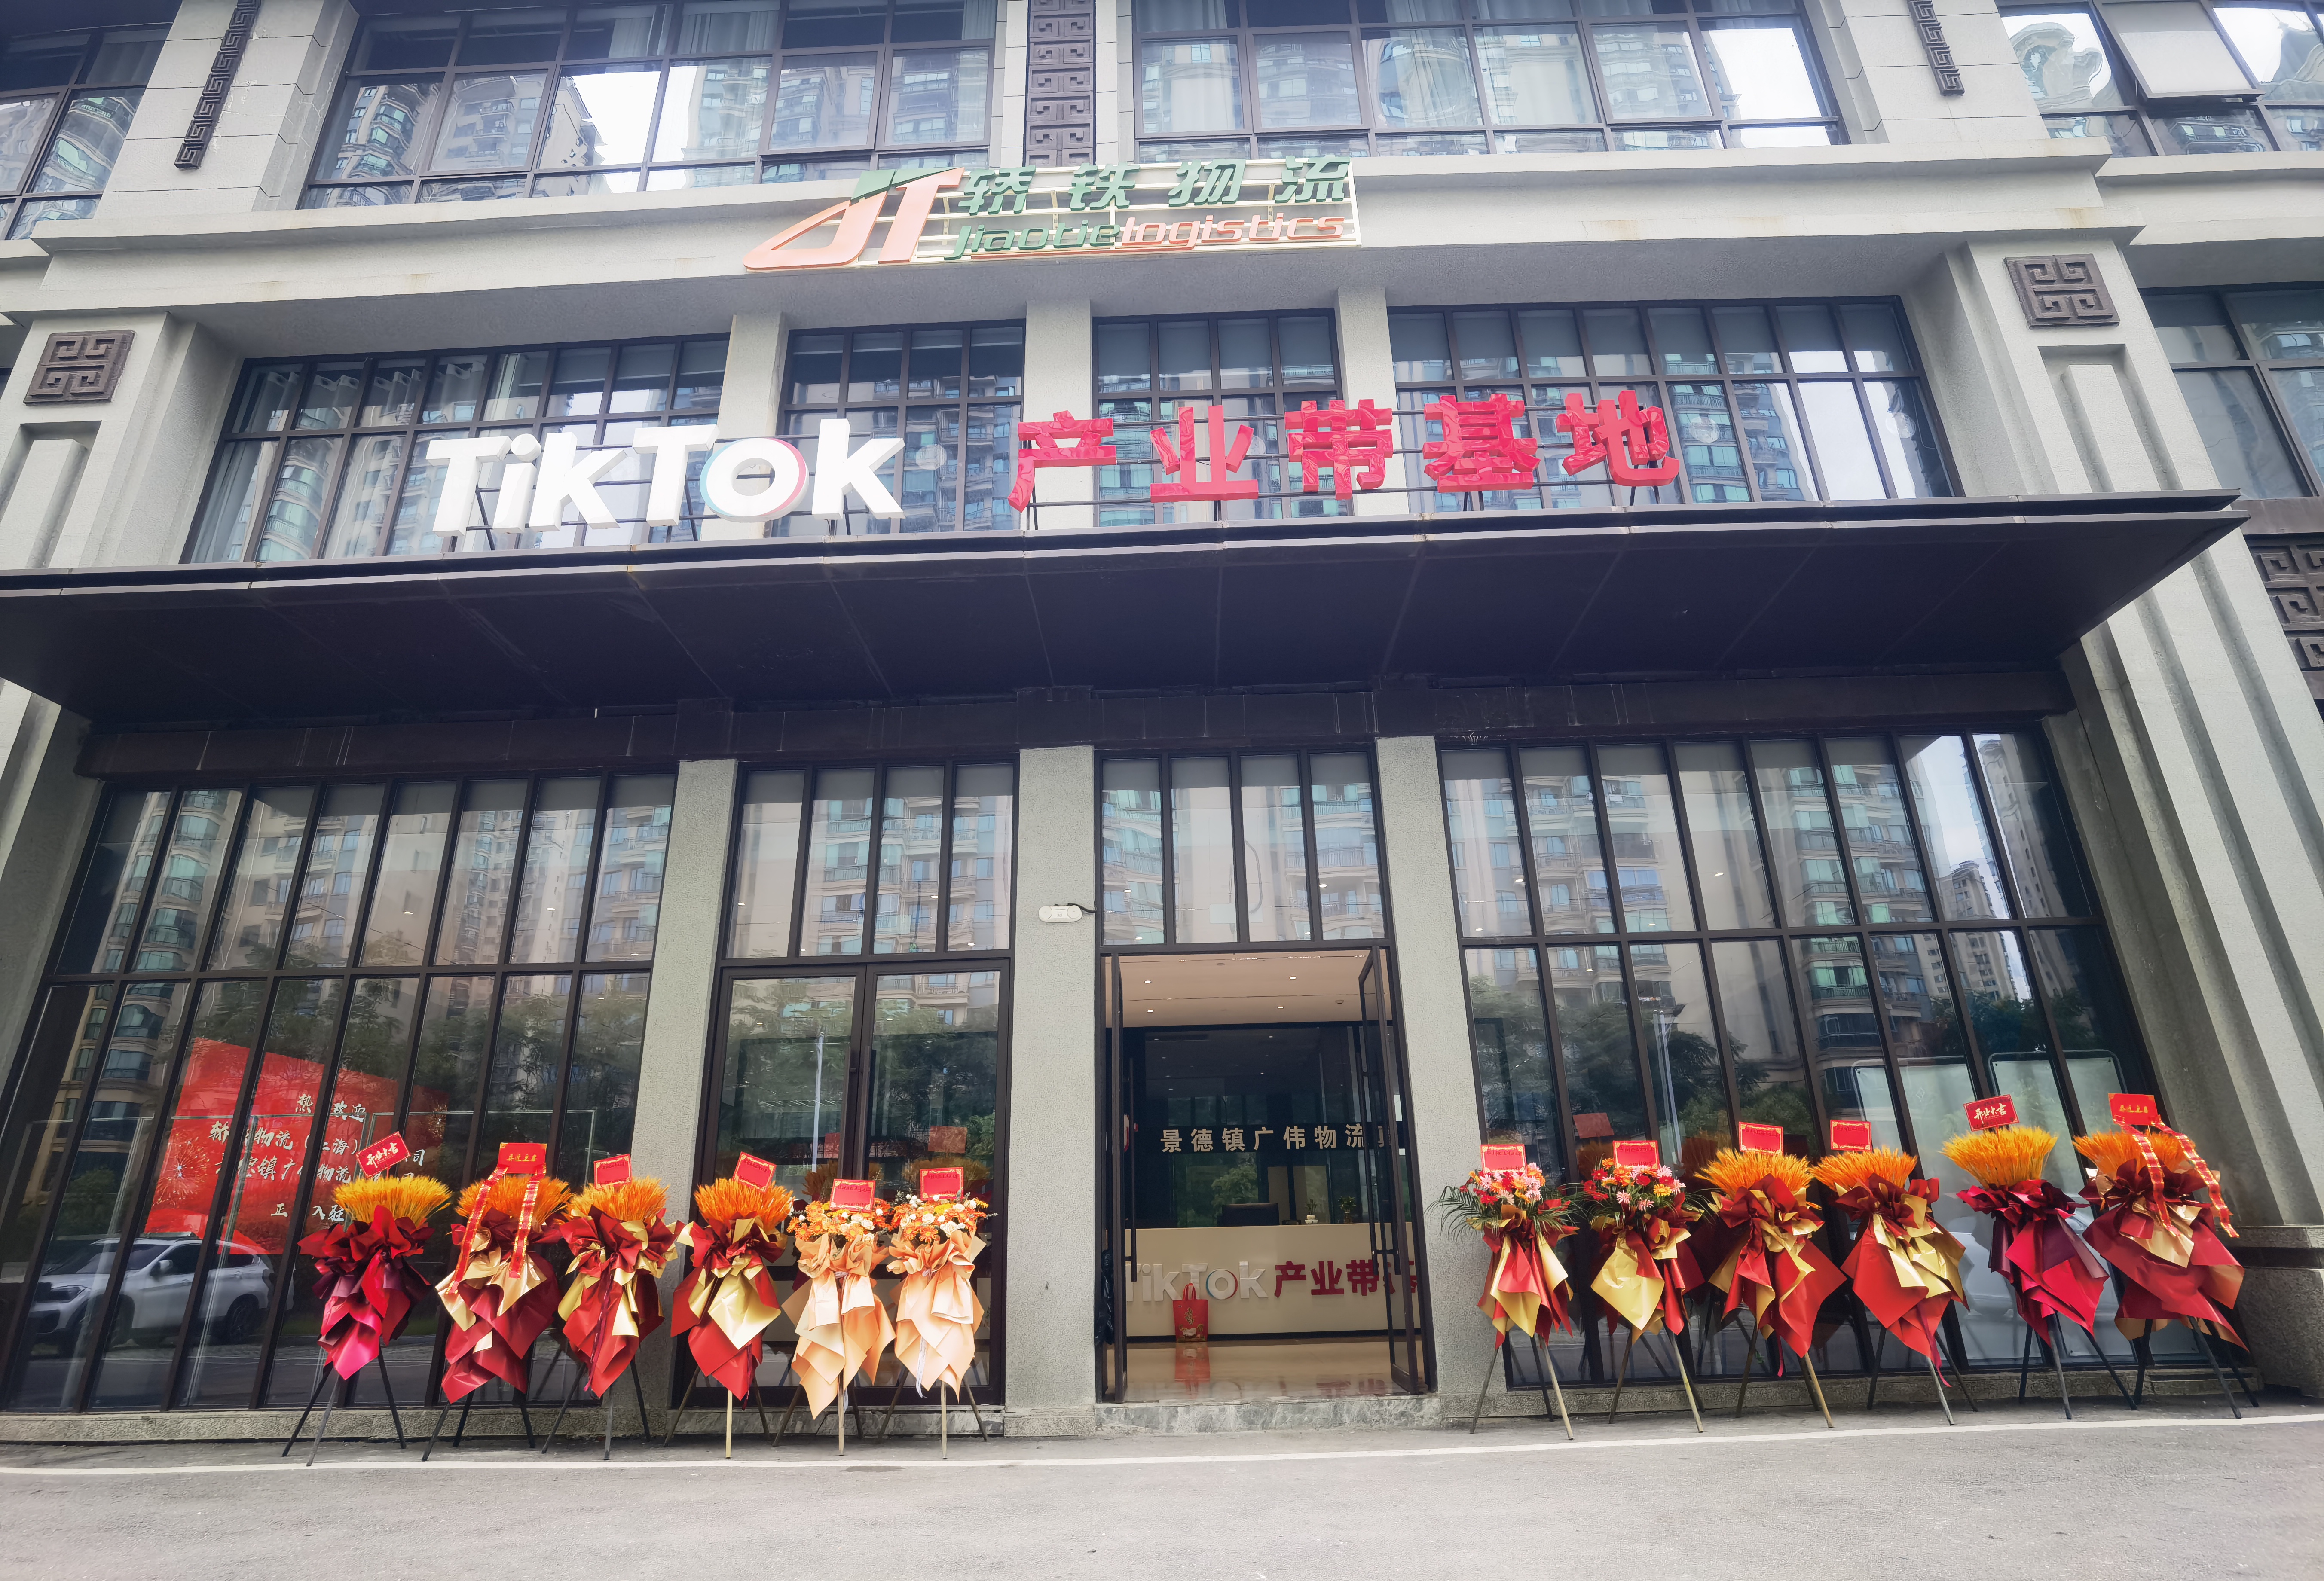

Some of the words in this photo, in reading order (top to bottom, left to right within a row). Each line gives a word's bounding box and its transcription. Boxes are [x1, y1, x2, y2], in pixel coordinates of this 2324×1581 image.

[958, 155, 1351, 216] 轿铁物流
[1008, 389, 1680, 511] 产业带基地
[425, 418, 905, 538] TikTok
[295, 1094, 366, 1122] 热欢迎
[1974, 1103, 2006, 1124] 开业大吉
[1160, 1123, 1391, 1153] 景德镇广伟物流
[366, 1142, 399, 1168] 开业大吉
[271, 1203, 344, 1222] 正入驻
